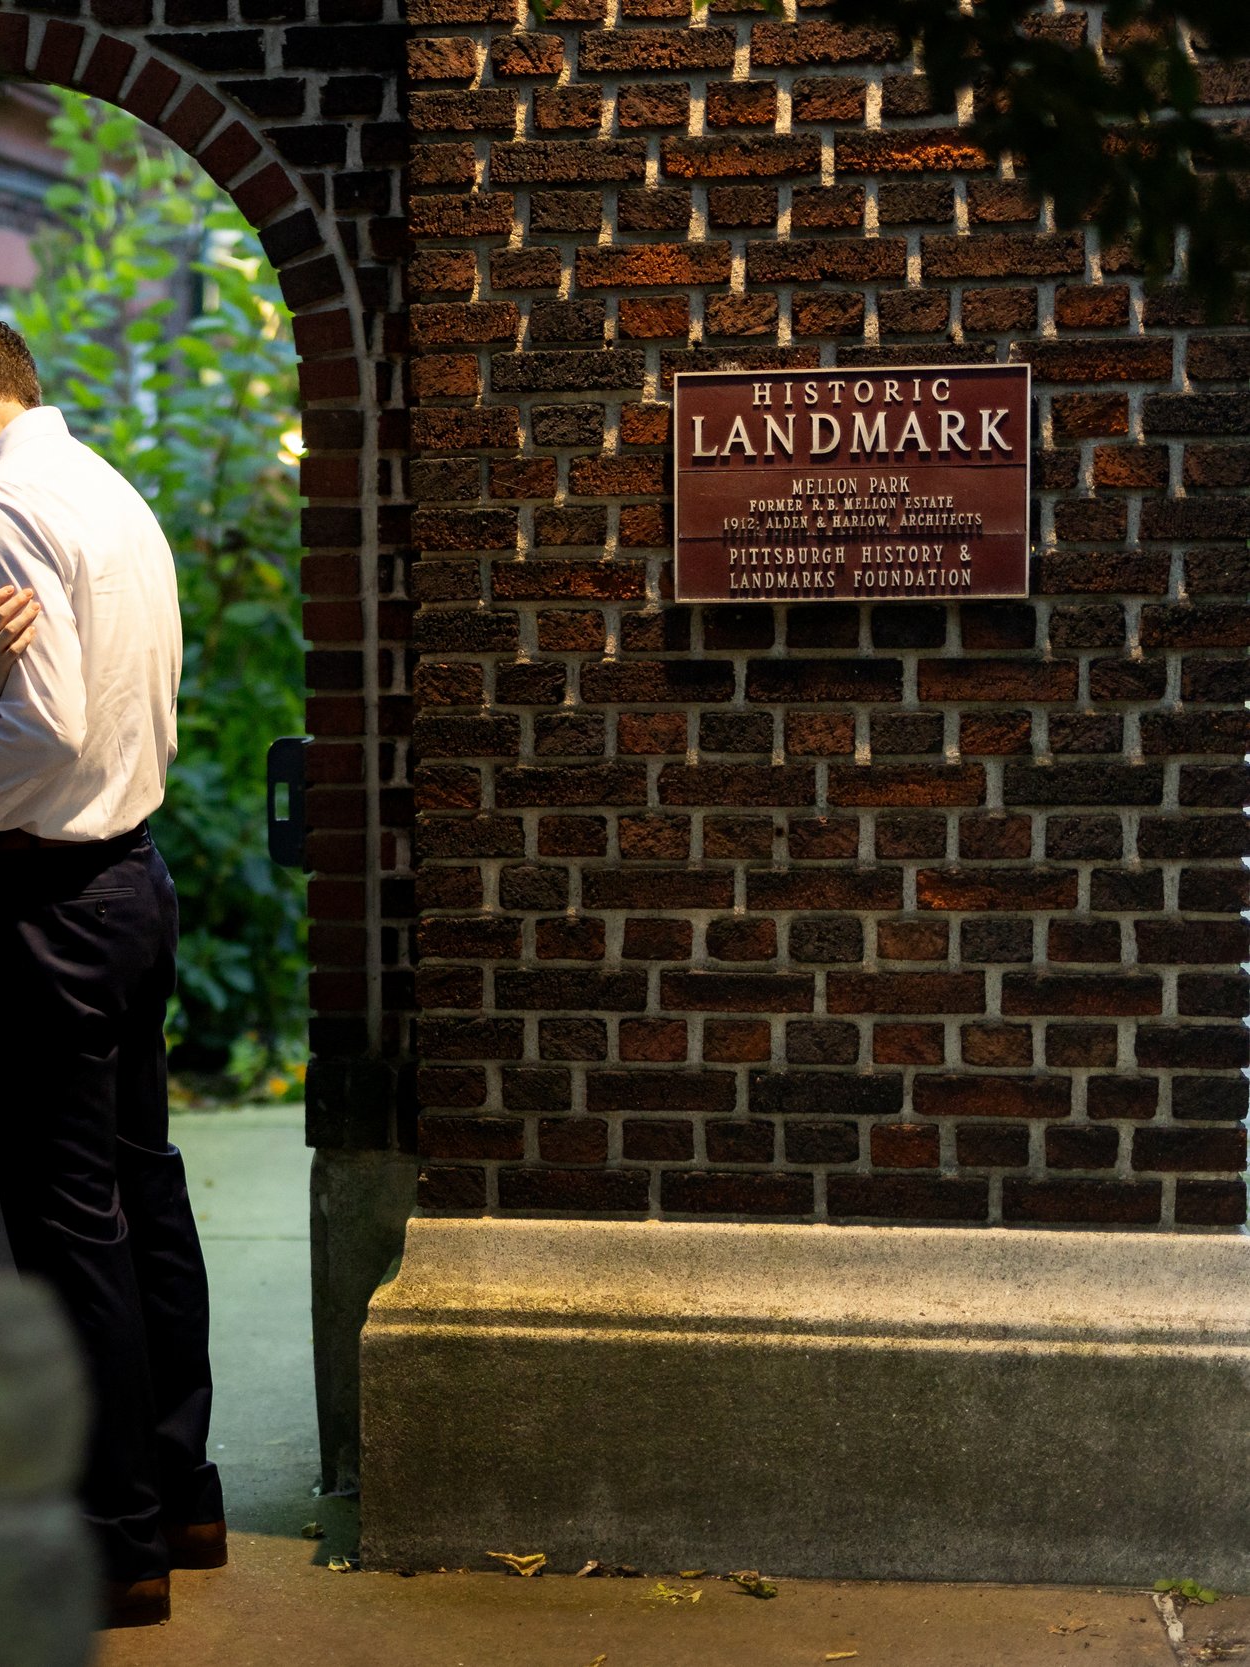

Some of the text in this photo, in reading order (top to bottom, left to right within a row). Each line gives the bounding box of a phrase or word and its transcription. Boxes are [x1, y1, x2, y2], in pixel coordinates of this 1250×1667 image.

[752, 378, 951, 406] HISTORIC
[692, 408, 1013, 457] LANDMARK
[792, 476, 910, 495] MELLON PARK
[749, 499, 803, 512] FORMER
[844, 498, 896, 510] MELLON
[905, 496, 954, 508] ESTATE
[766, 516, 808, 529] ALDEN
[816, 516, 827, 528] &
[900, 513, 983, 526] ARCHITECTS
[729, 545, 971, 565] PITTSBURGH HISTORY &
[730, 569, 971, 589] LANDMARKS FOUNDATION
